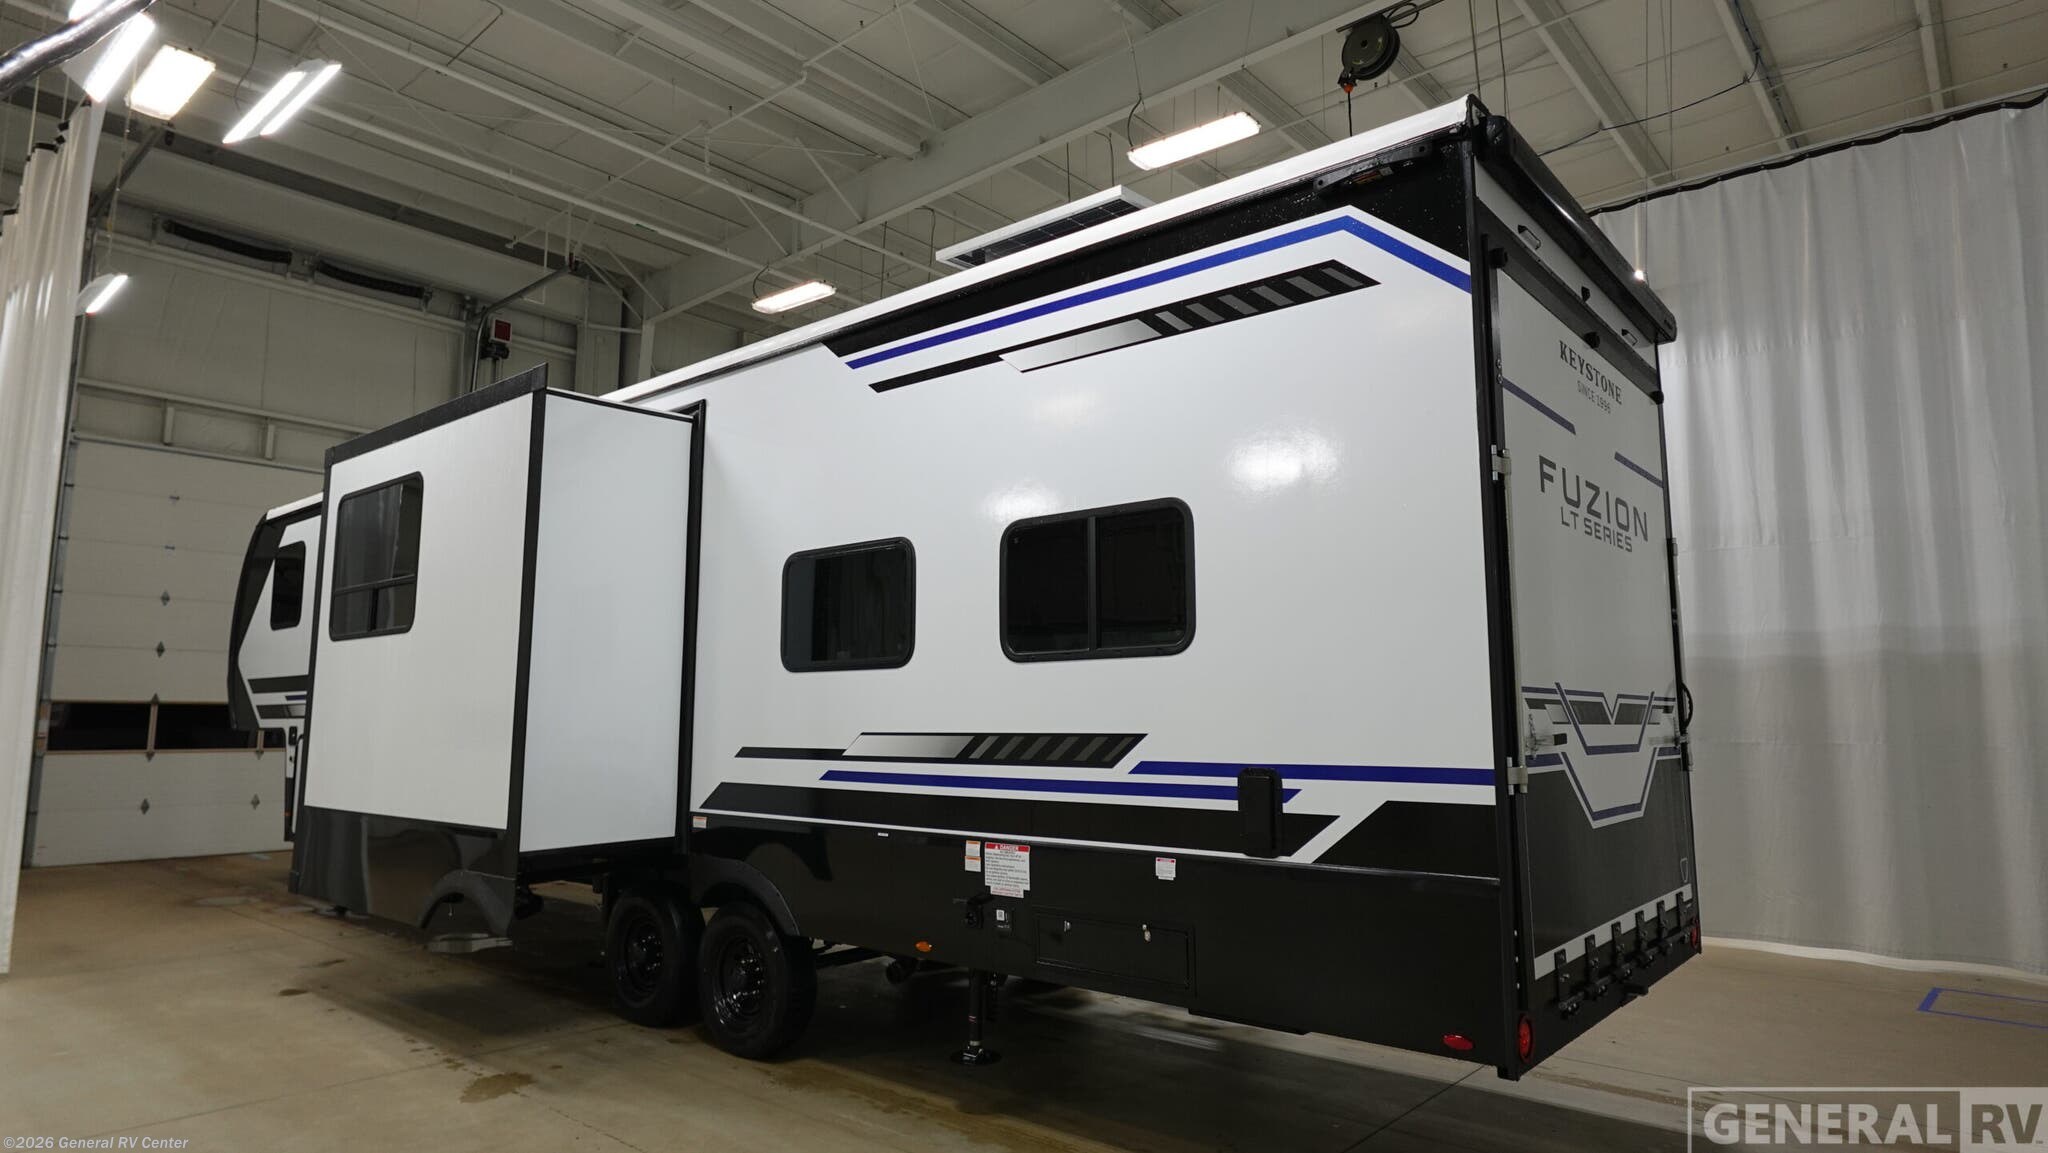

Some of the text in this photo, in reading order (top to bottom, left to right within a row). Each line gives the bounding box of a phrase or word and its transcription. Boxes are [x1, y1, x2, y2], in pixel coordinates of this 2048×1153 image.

[1559, 339, 1622, 405] KEYSTONE
[1577, 380, 1595, 403] SINCE
[1538, 453, 1648, 542] FUZION
[1560, 506, 1633, 553] LT SERIES
